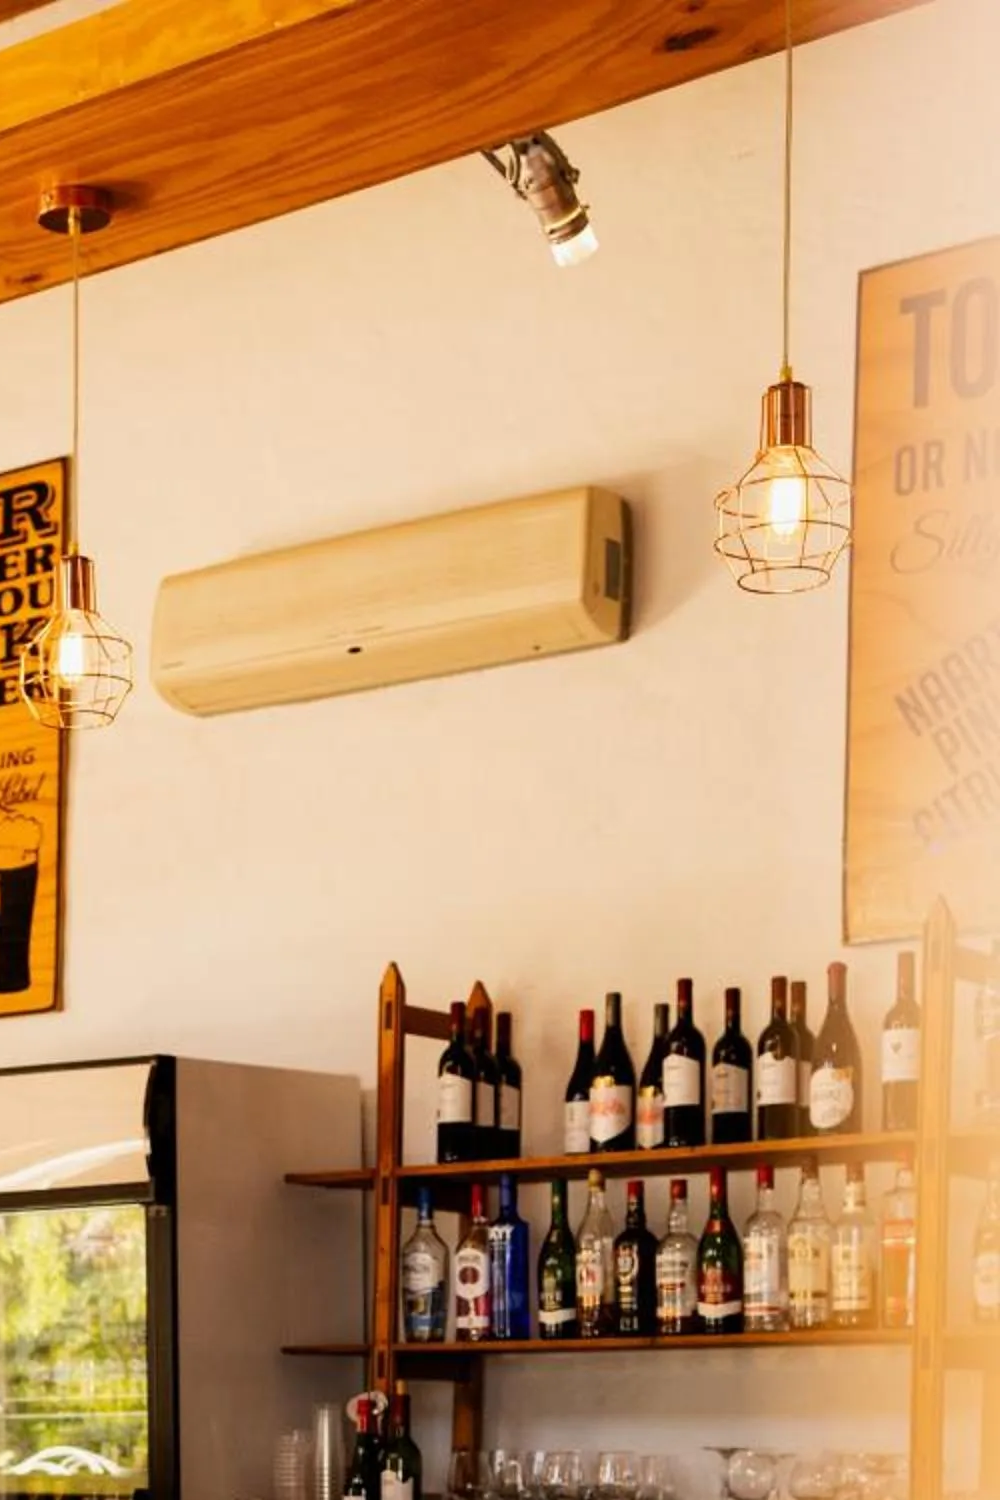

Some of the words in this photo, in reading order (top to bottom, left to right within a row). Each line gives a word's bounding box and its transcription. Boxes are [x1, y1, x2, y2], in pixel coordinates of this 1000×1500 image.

[899, 277, 999, 409] TO
[894, 439, 945, 496] OR
[963, 427, 1000, 483] N
[932, 690, 1000, 776] PIN
